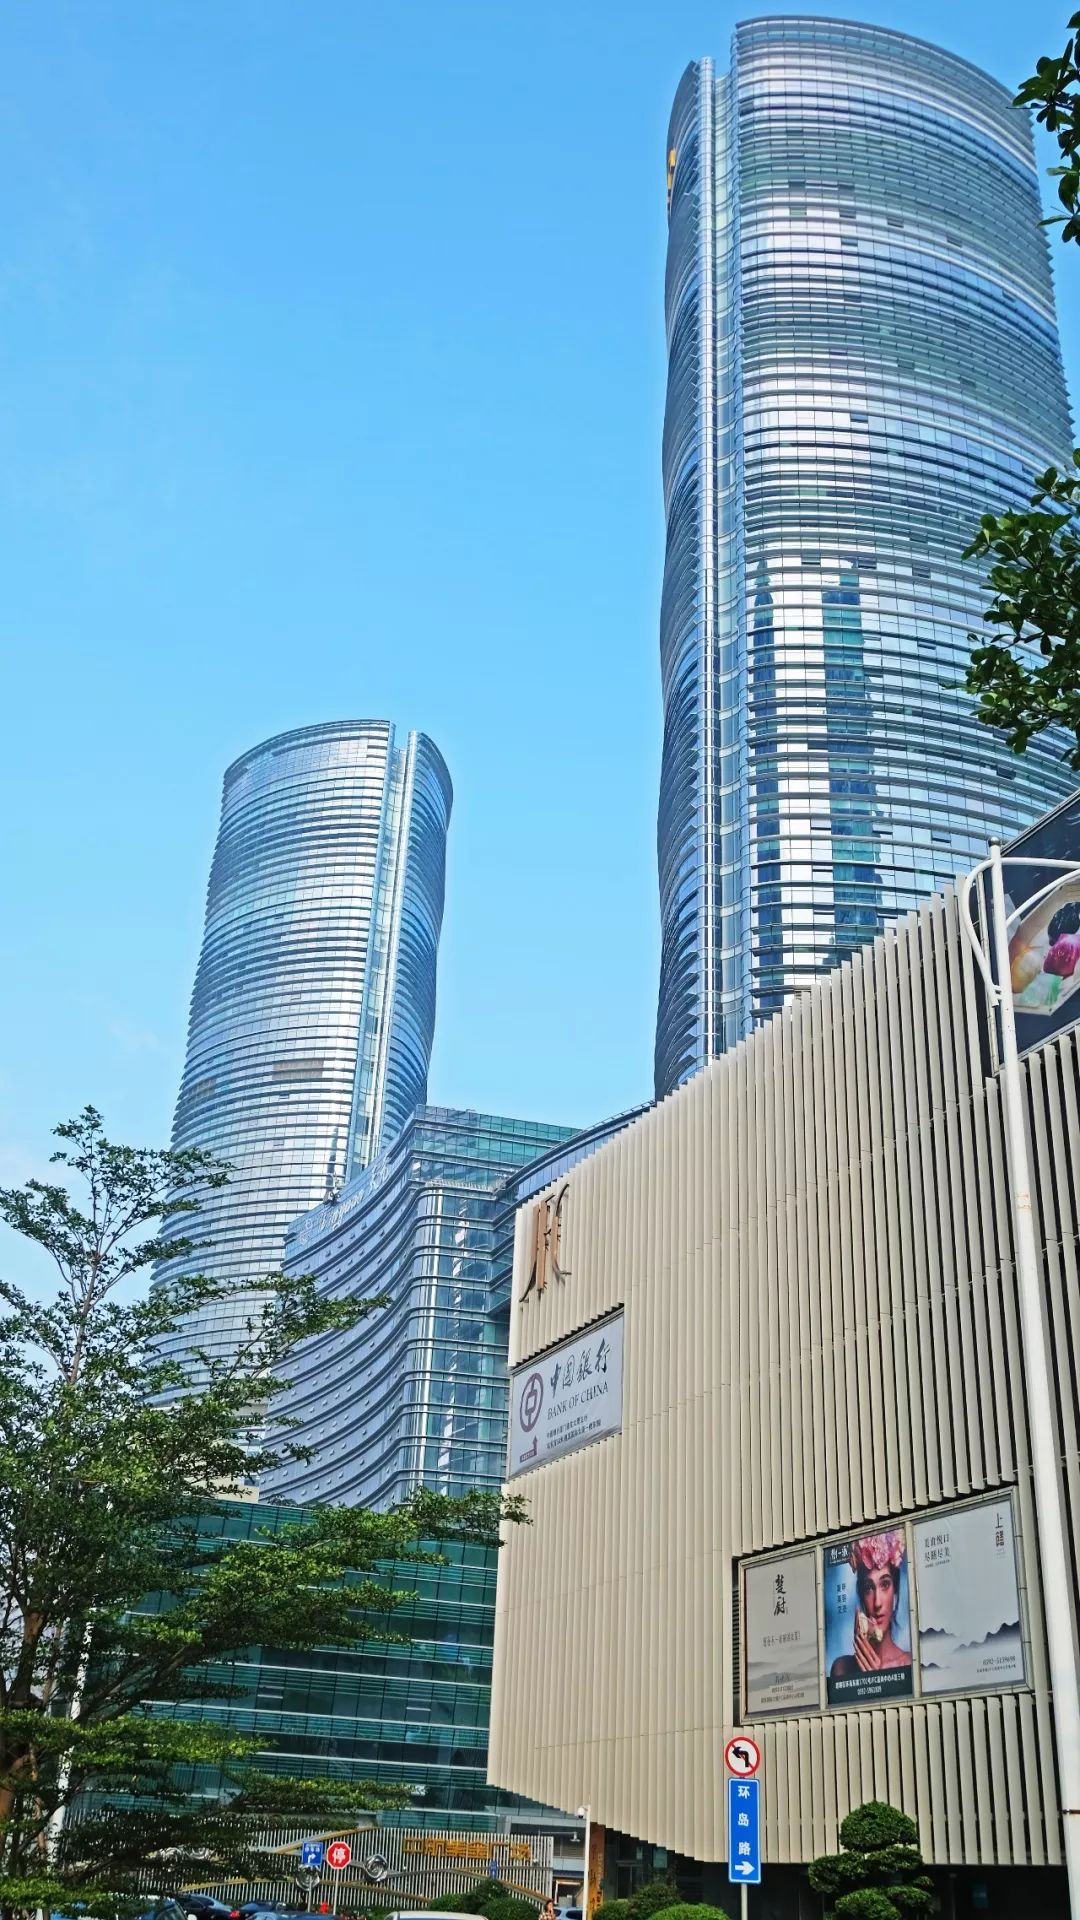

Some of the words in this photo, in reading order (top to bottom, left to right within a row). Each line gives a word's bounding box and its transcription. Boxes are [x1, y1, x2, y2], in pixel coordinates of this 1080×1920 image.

[550, 1337, 611, 1399] 中国银行
[547, 1399, 568, 1421] BANK
[568, 1393, 580, 1409] OF
[580, 1381, 609, 1404] CHINA
[737, 1785, 751, 1856] 环岛路
[332, 1847, 346, 1864] 停
